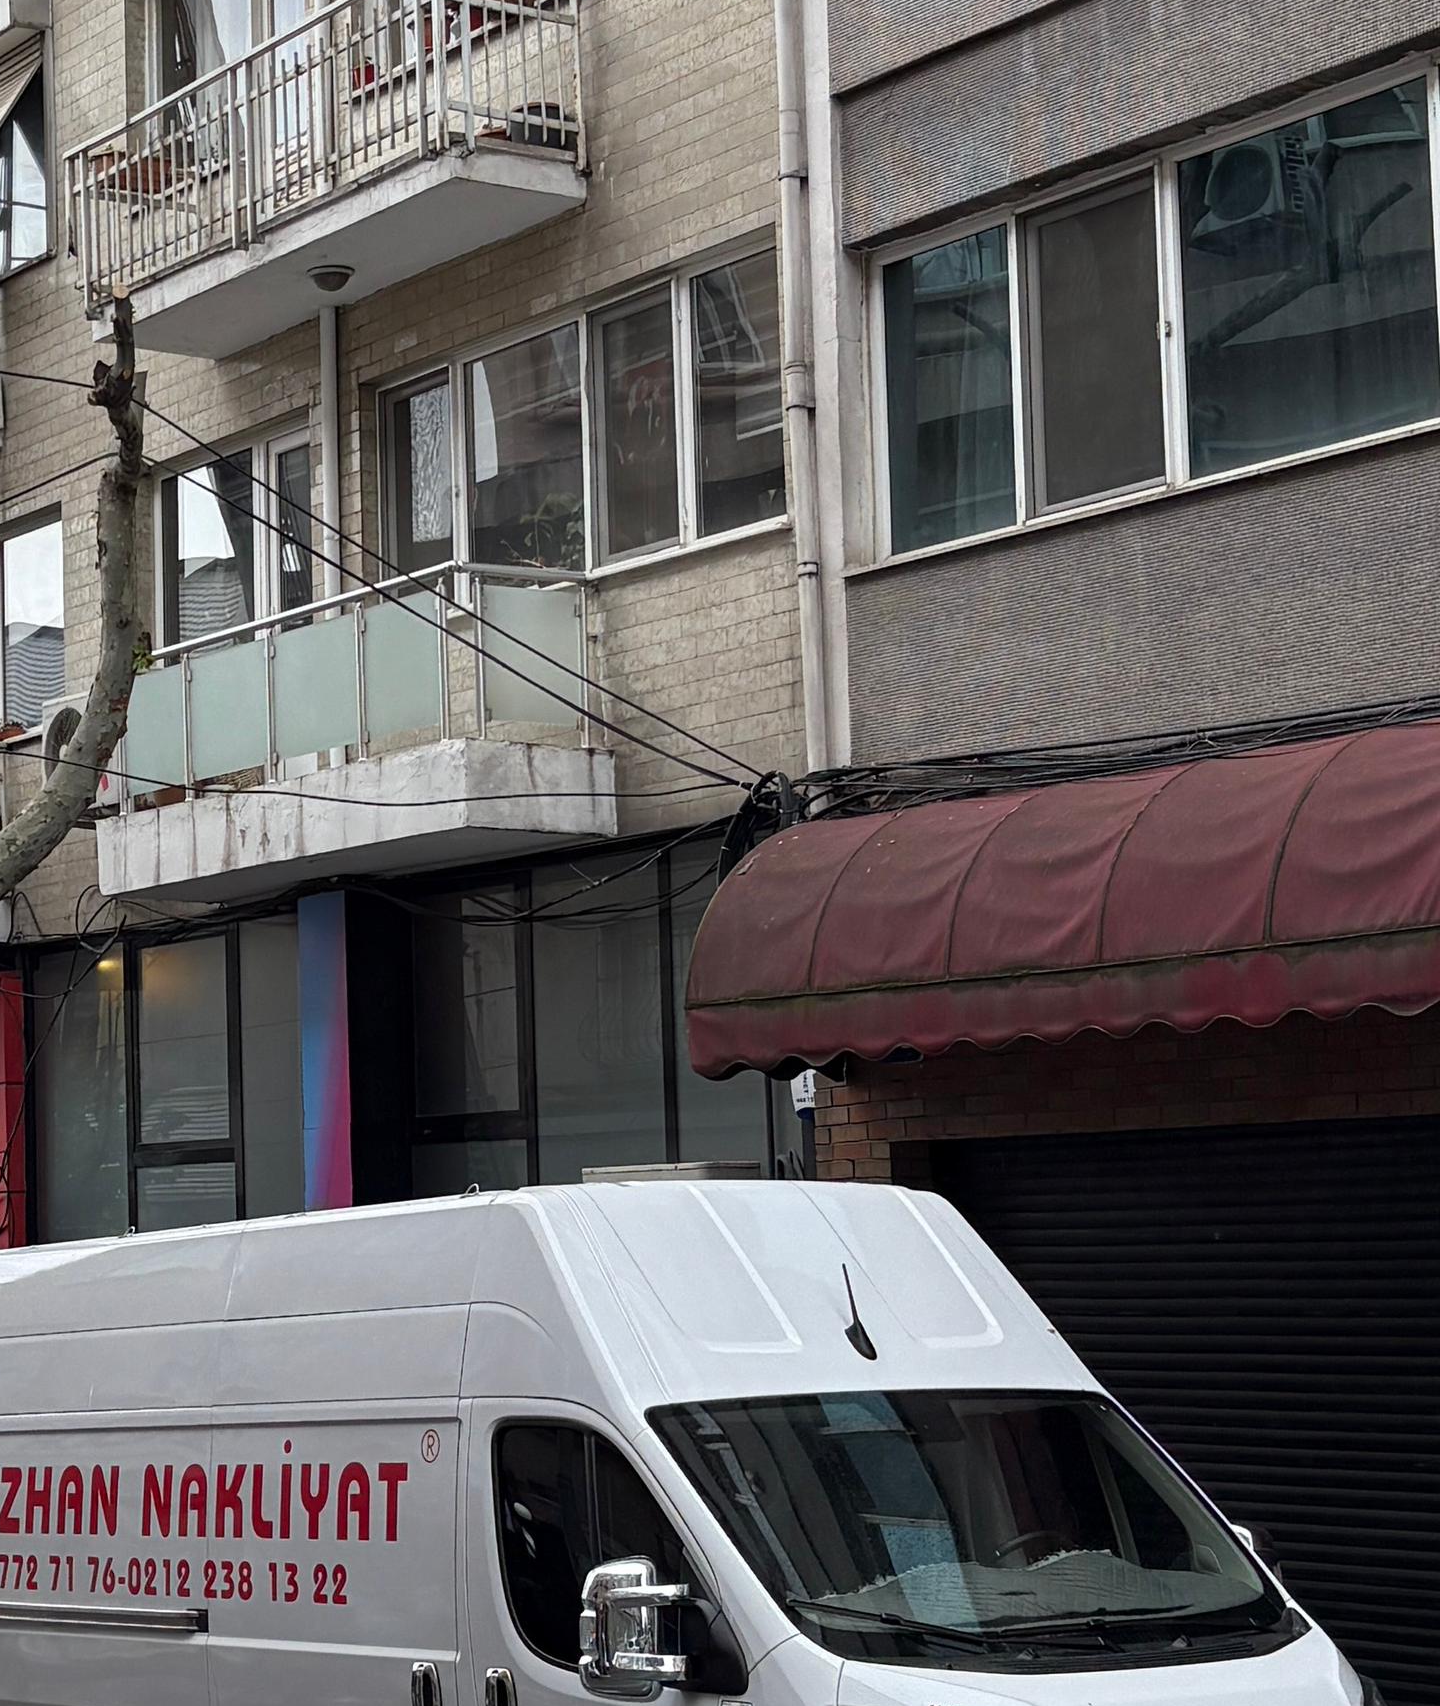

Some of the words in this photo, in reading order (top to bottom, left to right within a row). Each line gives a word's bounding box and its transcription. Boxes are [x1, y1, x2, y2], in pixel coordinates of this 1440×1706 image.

[141, 1439, 408, 1542] NAKLİYAT
[49, 1555, 74, 1592] 71
[203, 1559, 253, 1601] 238
[268, 1562, 299, 1603] 13
[313, 1563, 348, 1605] 22
